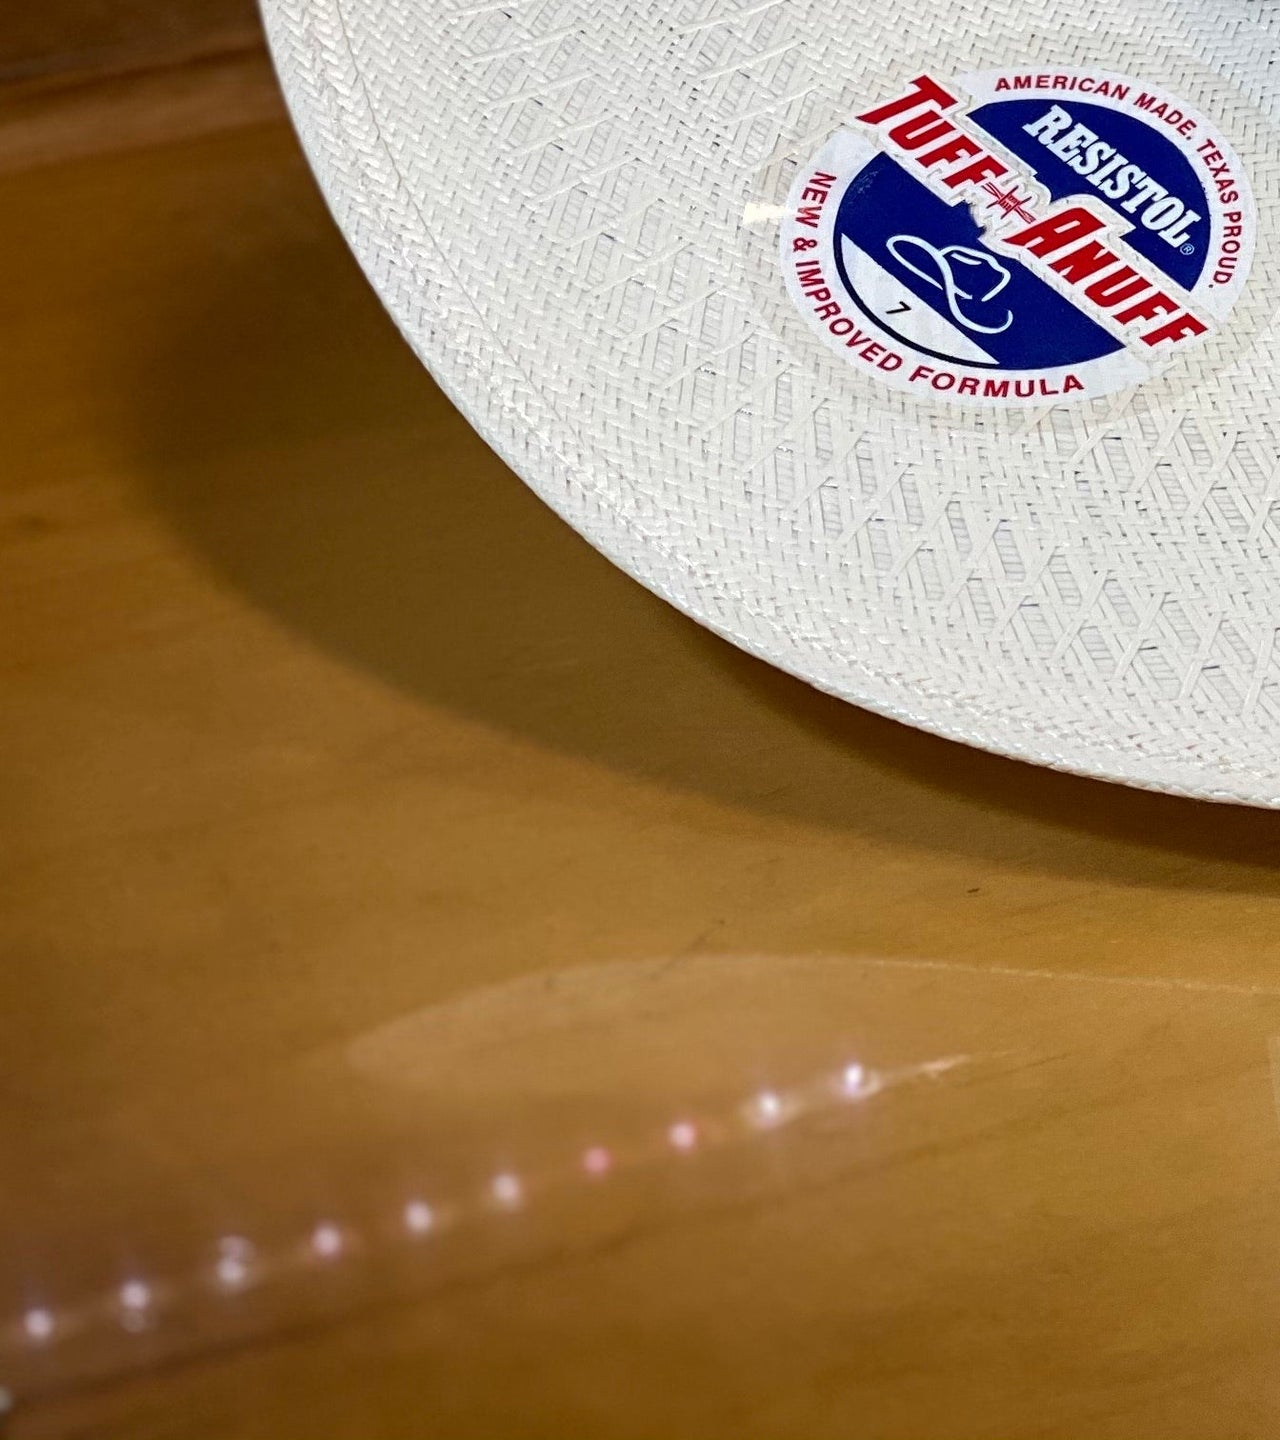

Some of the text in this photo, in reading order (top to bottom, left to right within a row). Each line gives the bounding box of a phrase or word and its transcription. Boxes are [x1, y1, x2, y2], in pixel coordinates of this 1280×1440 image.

[793, 171, 1084, 398] NEW & IMPROVED FORMULA
[856, 75, 1208, 347] TUFF ANUFF
[995, 74, 1242, 289] AMERICAN MADE. TEXAS PROUD.
